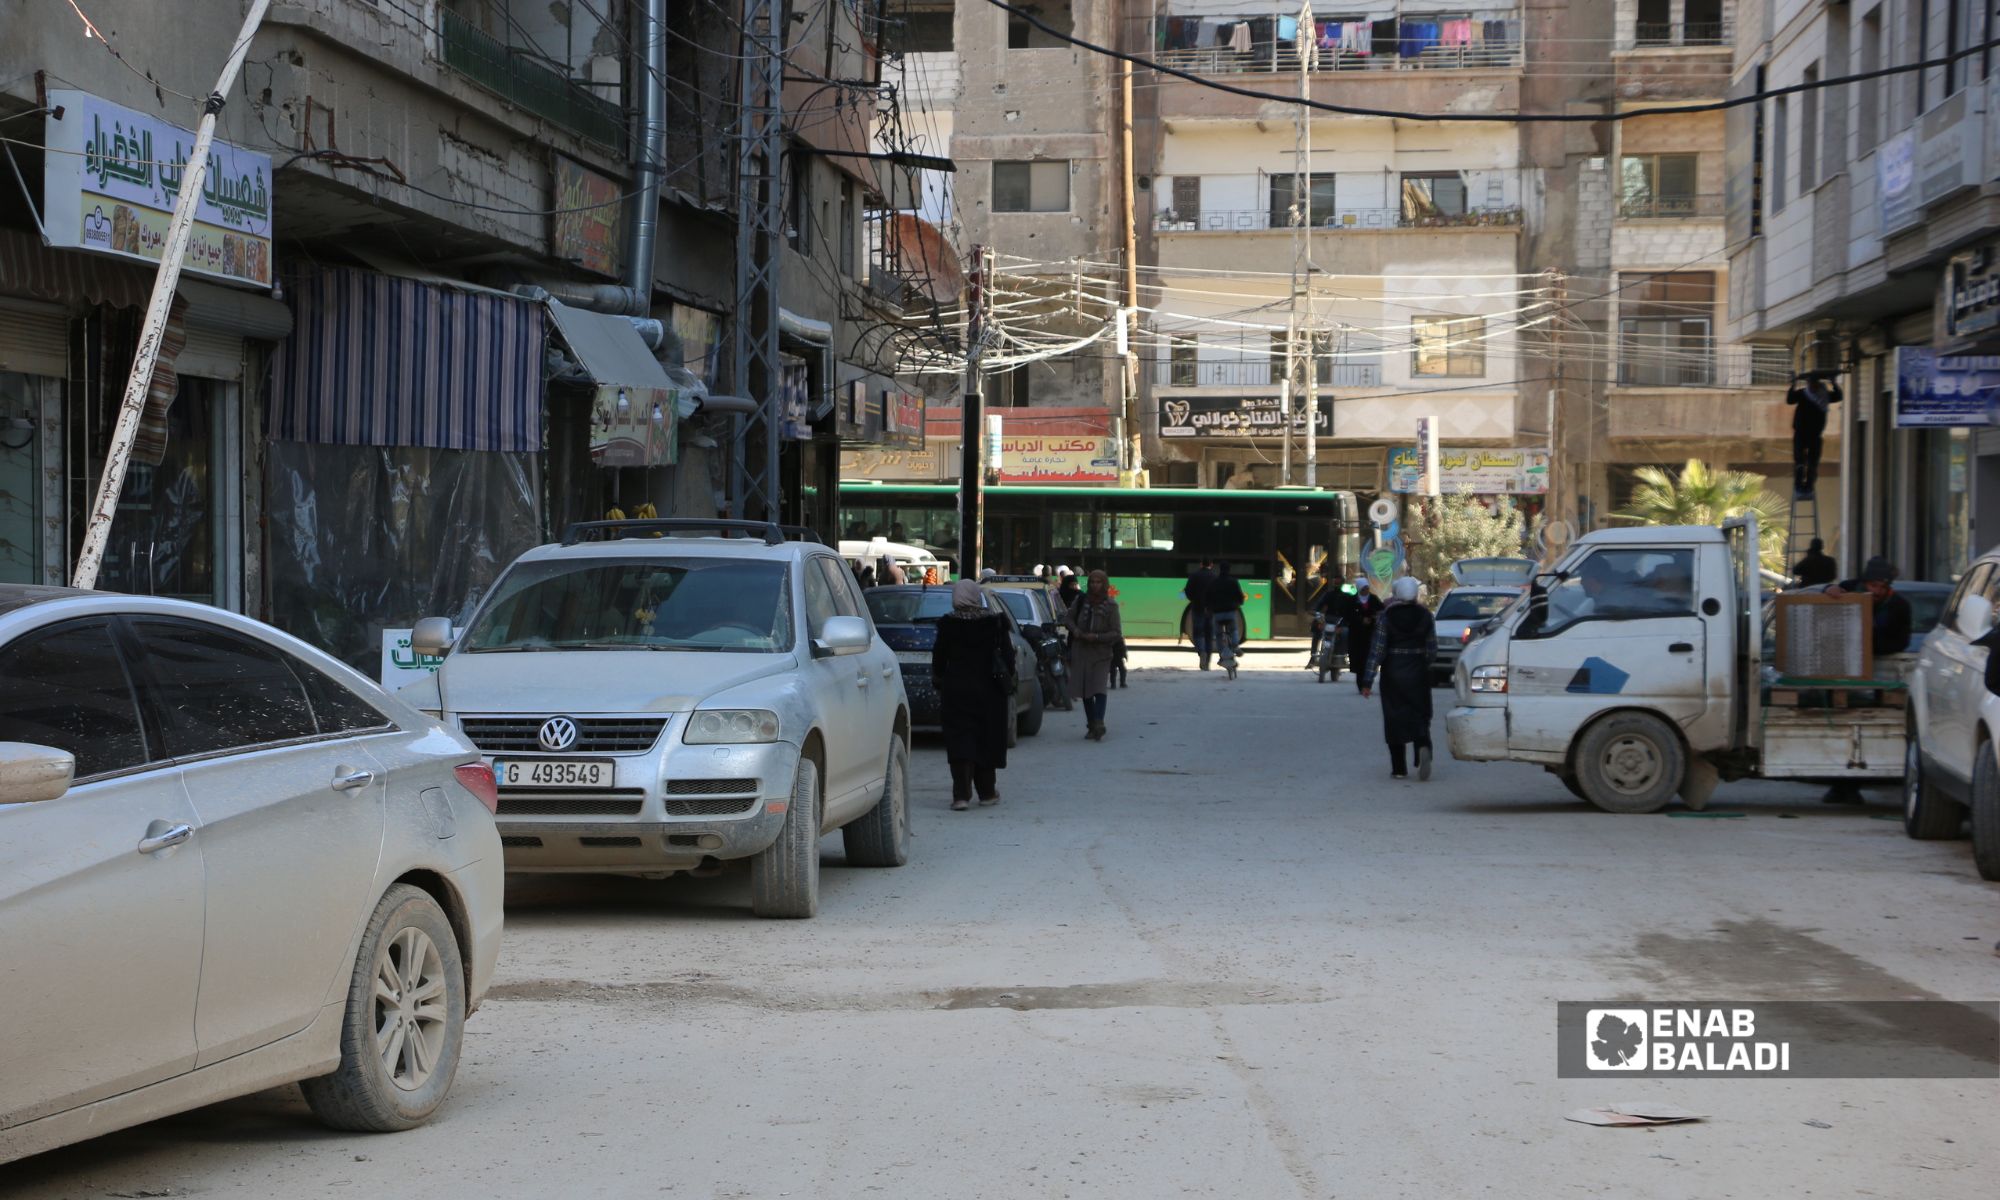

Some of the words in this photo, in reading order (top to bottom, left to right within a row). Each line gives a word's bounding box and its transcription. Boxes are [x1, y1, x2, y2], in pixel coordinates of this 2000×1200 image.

[86, 113, 153, 189] الخضراء
[1049, 440, 1096, 454] مكتب
[507, 764, 520, 784] G
[531, 763, 601, 784] 493549
